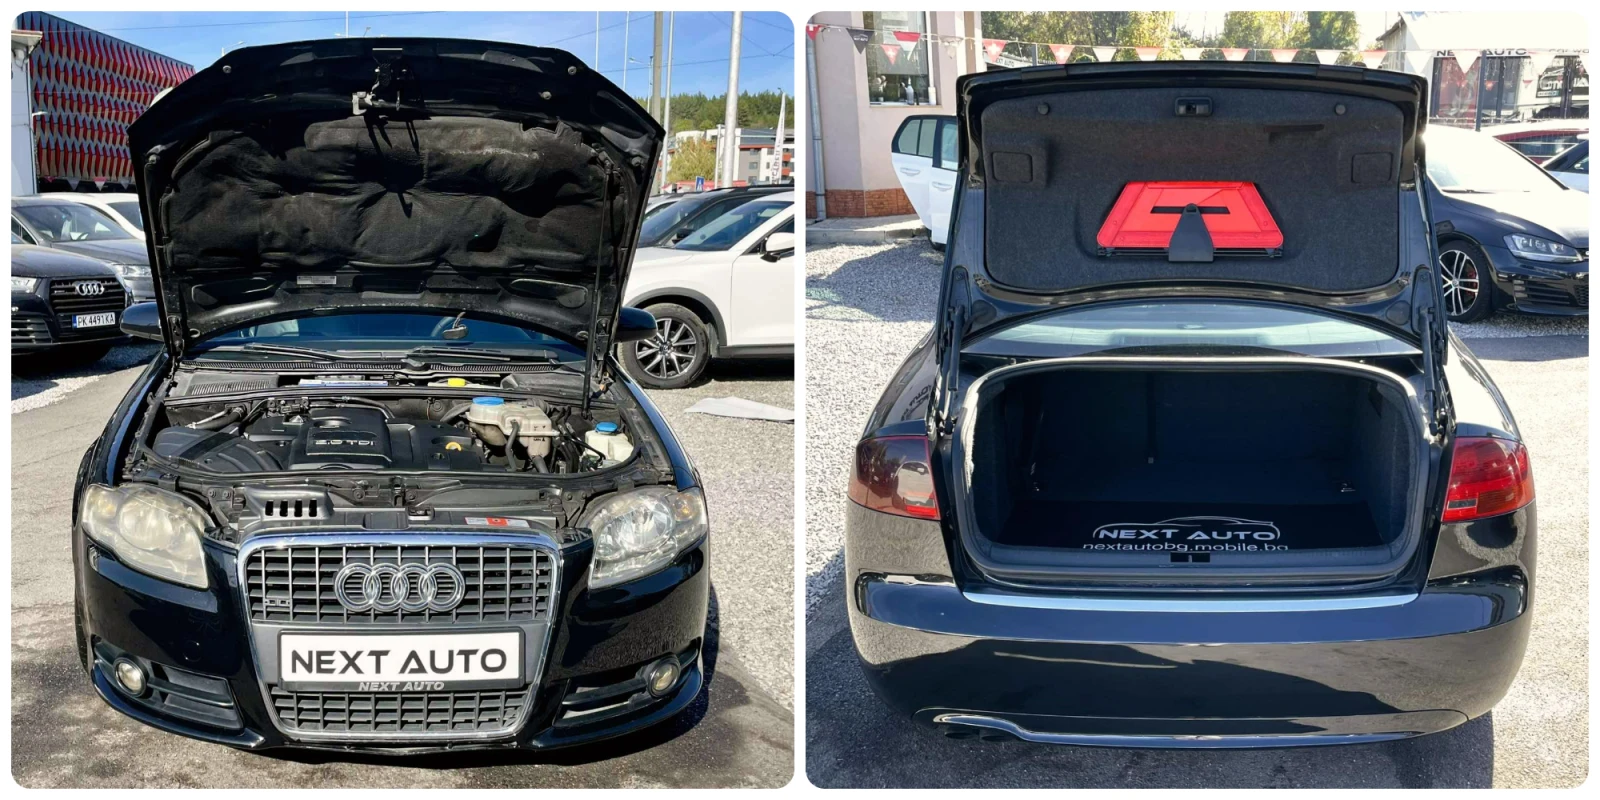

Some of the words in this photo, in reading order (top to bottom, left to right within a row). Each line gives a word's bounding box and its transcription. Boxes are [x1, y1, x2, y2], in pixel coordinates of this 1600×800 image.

[1483, 48, 1528, 56] AUTO
[1099, 528, 1180, 539] NEXT
[1187, 531, 1276, 541] AUTO
[291, 649, 391, 675] NEXT
[398, 648, 508, 675] AUTO
[359, 682, 401, 692] NEXT
[402, 681, 446, 691] AUTO
